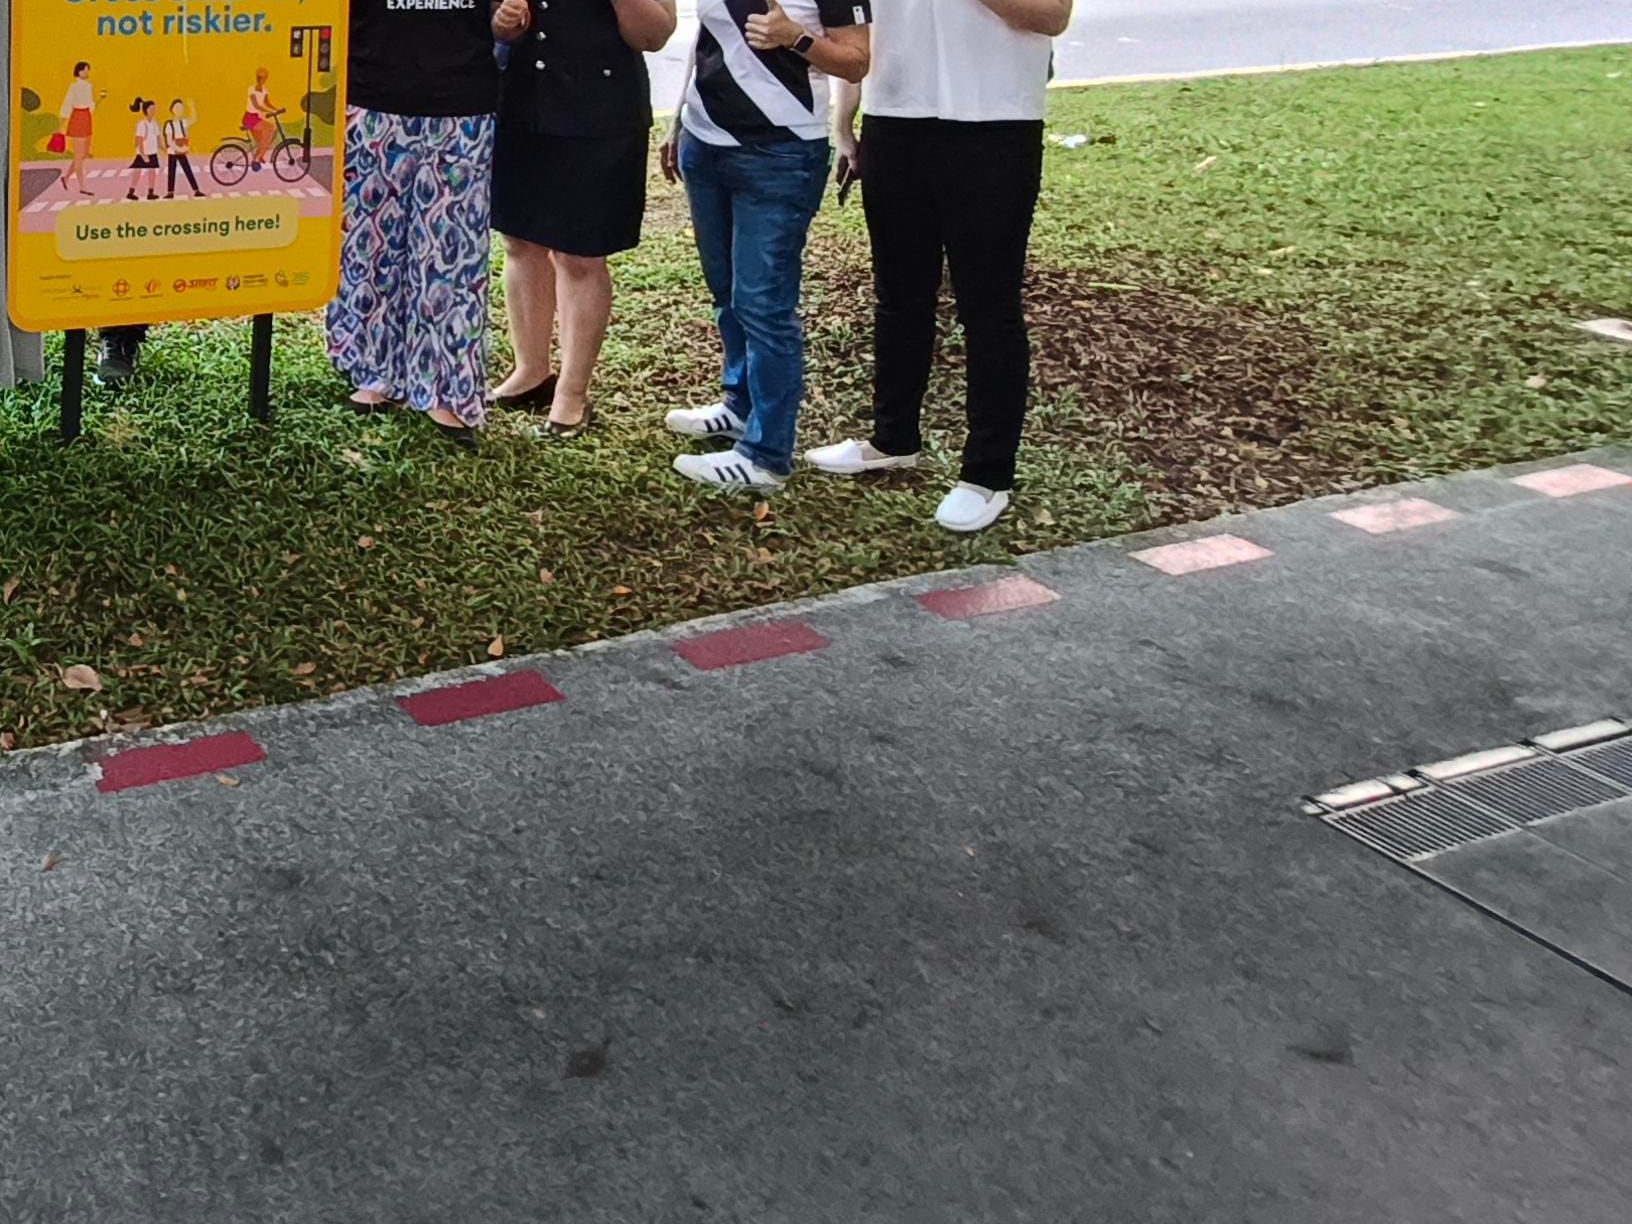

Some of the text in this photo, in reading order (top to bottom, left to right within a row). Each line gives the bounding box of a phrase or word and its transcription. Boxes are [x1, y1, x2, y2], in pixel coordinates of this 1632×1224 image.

[97, 4, 273, 36] not riskier.
[76, 213, 280, 241] Use the crossing here!
